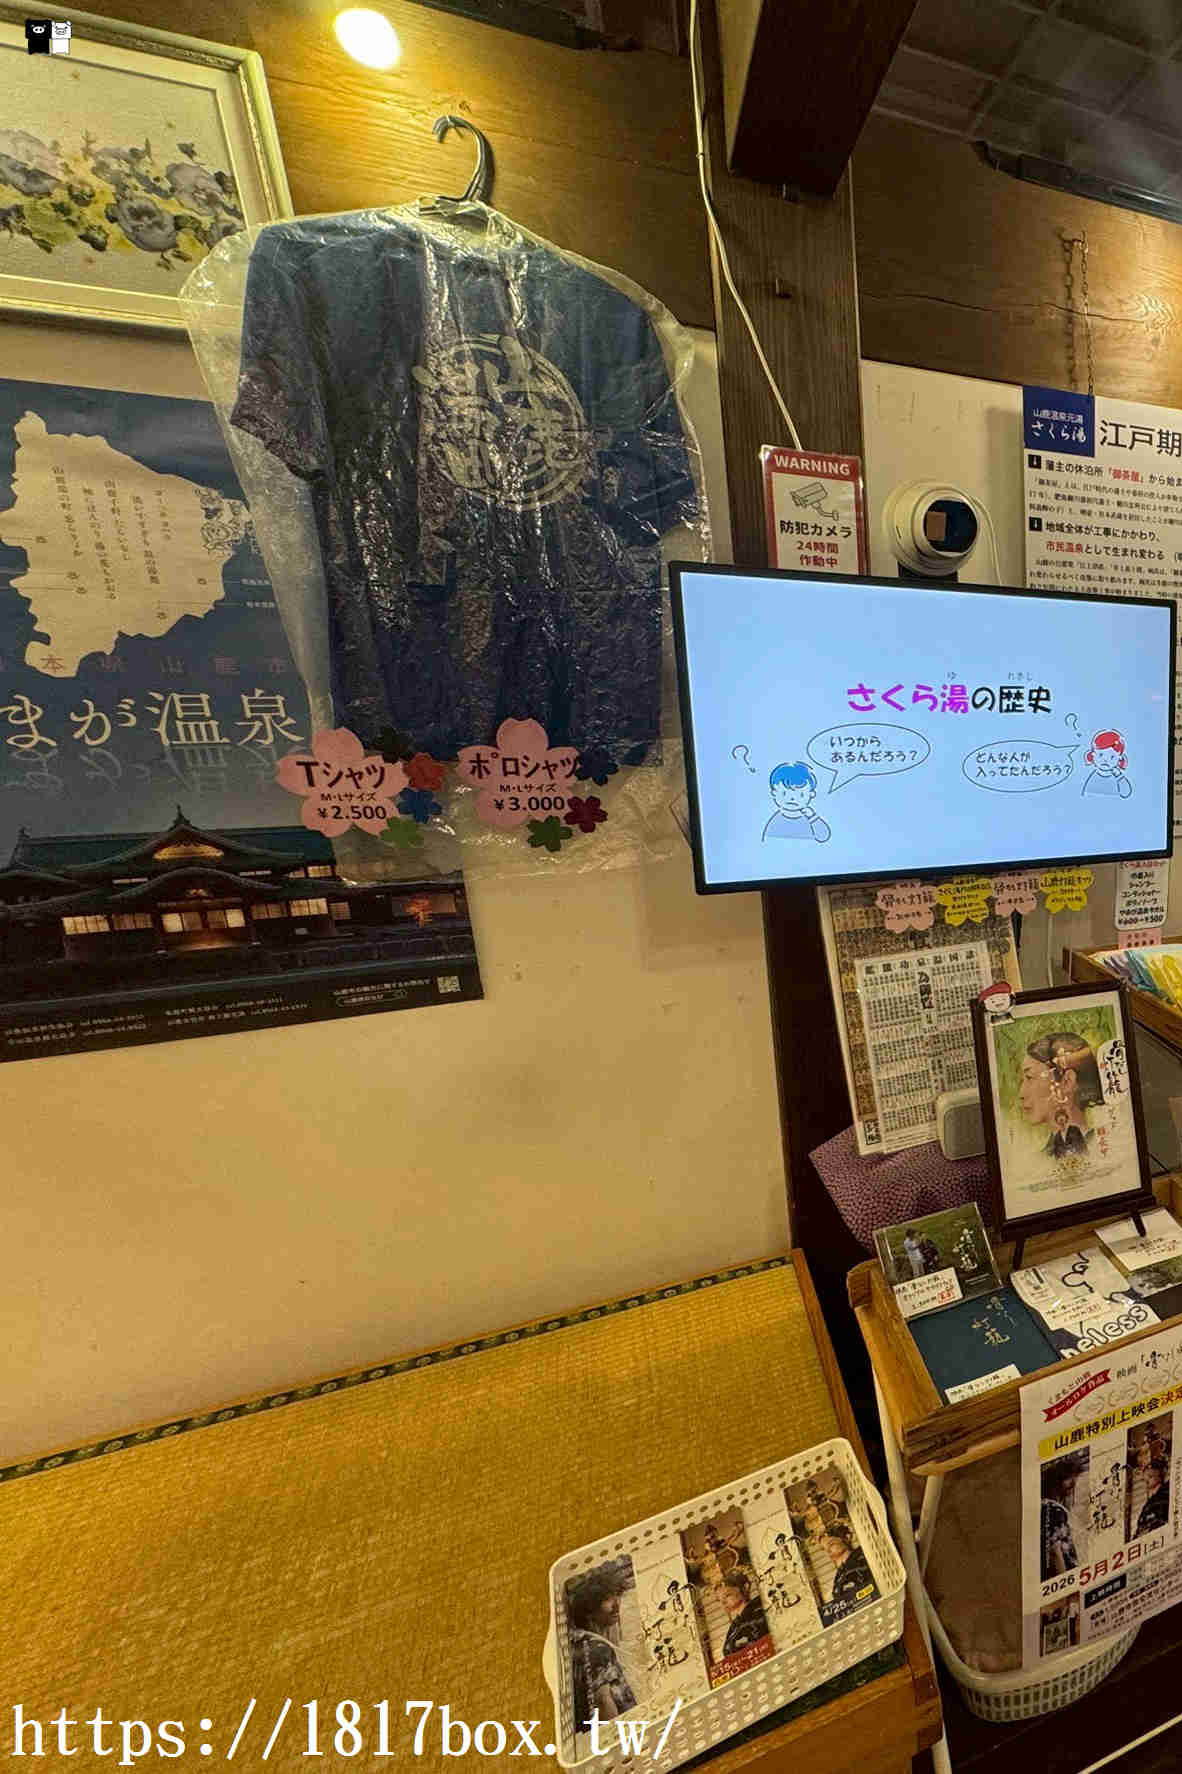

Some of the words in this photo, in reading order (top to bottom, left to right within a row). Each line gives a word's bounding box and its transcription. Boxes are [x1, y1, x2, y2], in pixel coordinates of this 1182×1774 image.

[1030, 422, 1087, 444] さくら湯
[774, 455, 850, 475] WARNING
[780, 520, 852, 538] 防犯カメラ
[797, 541, 838, 553] 24時間
[800, 554, 837, 568] 作動中
[846, 683, 1052, 714] さくら湯の歴史
[830, 736, 881, 750] いつから
[469, 752, 579, 779] ポロシャツ
[975, 752, 1031, 764] どんな人が
[296, 760, 386, 789] Tシャツ
[1042, 1576, 1075, 1597] 2026
